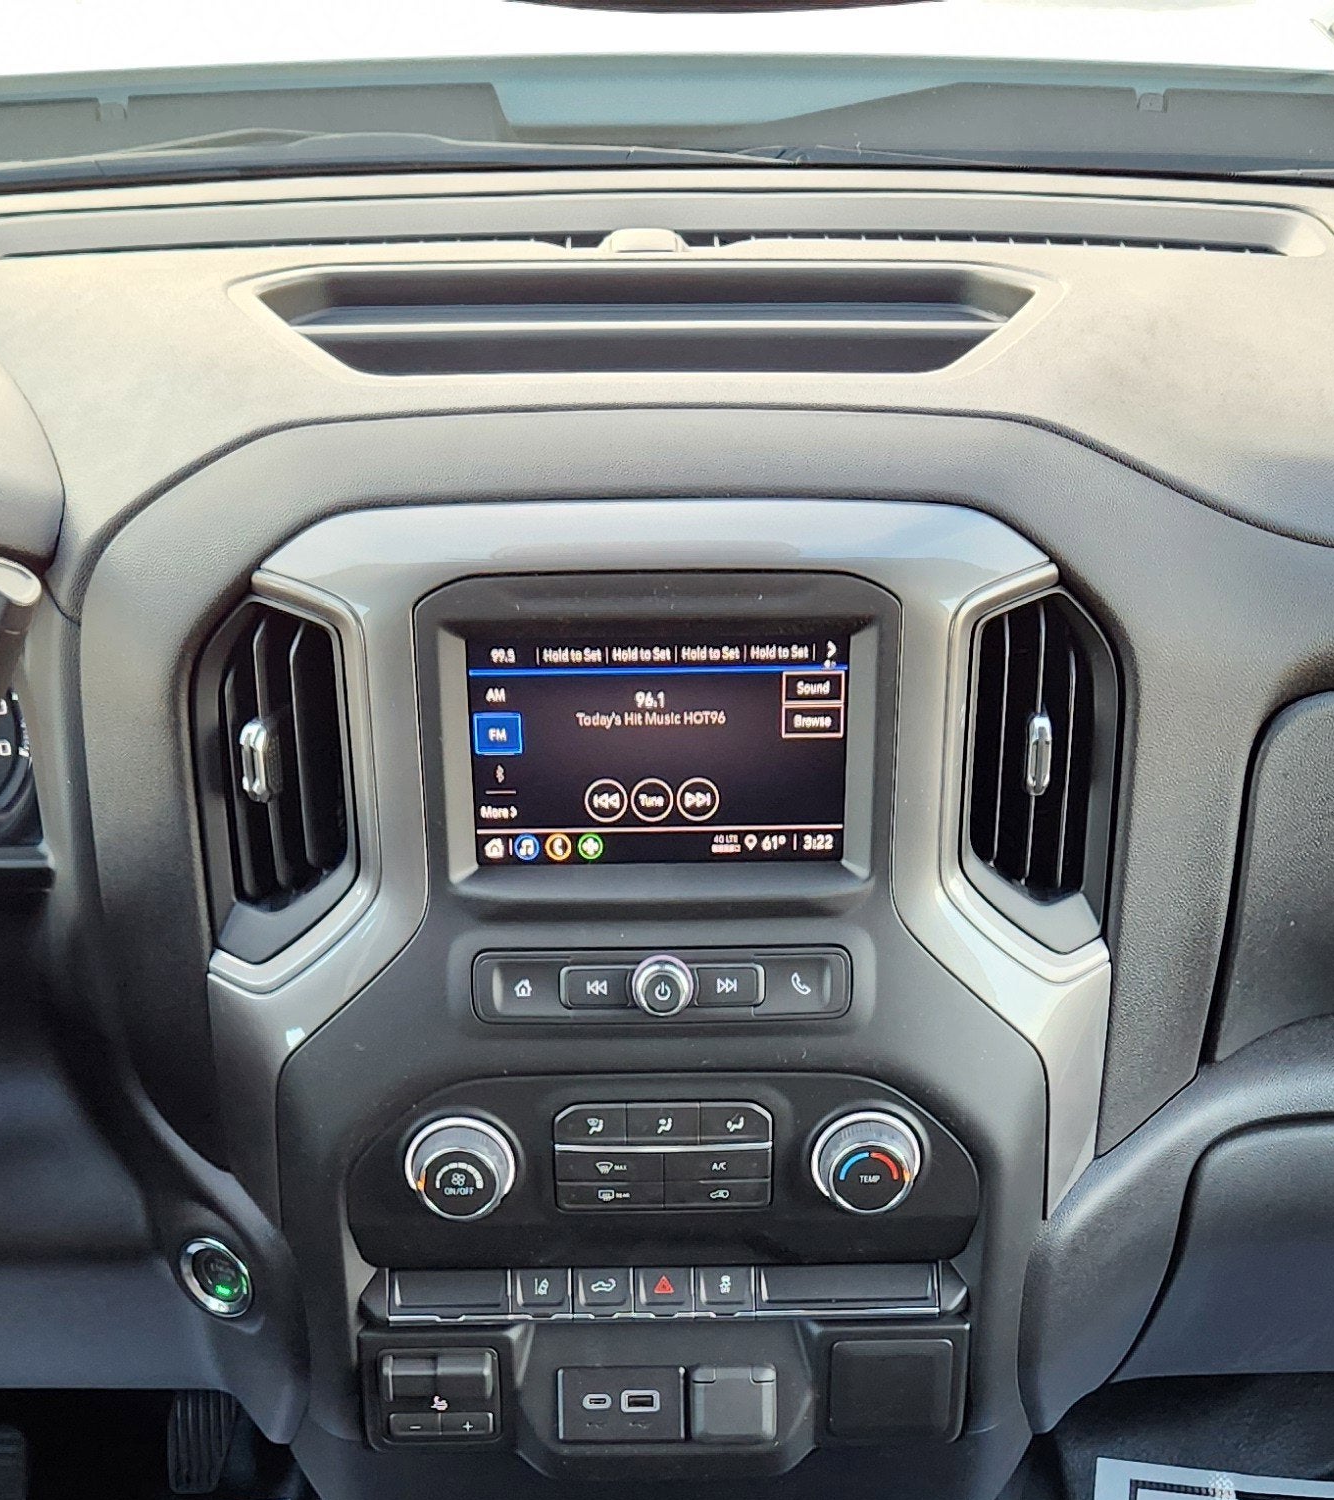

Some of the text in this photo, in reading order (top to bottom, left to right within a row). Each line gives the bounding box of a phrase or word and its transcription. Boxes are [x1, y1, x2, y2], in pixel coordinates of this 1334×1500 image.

[542, 647, 602, 663] Hold to Set
[612, 646, 671, 662] Hold to Set
[681, 646, 740, 661] Hold to Set
[750, 645, 809, 660] Hold to Set
[486, 688, 507, 702] AM
[796, 680, 831, 695] Sound
[634, 690, 666, 708] 96.1
[576, 710, 727, 729] Today's Hit Music HOT96
[793, 714, 832, 729] Browse
[488, 728, 508, 742] FM
[638, 793, 664, 807] Tune
[480, 806, 509, 819] More
[803, 834, 834, 850] 3:22
[711, 1162, 727, 1171] A/C
[859, 1174, 881, 1184] TEMP
[444, 1186, 475, 1196] ON/OFF
